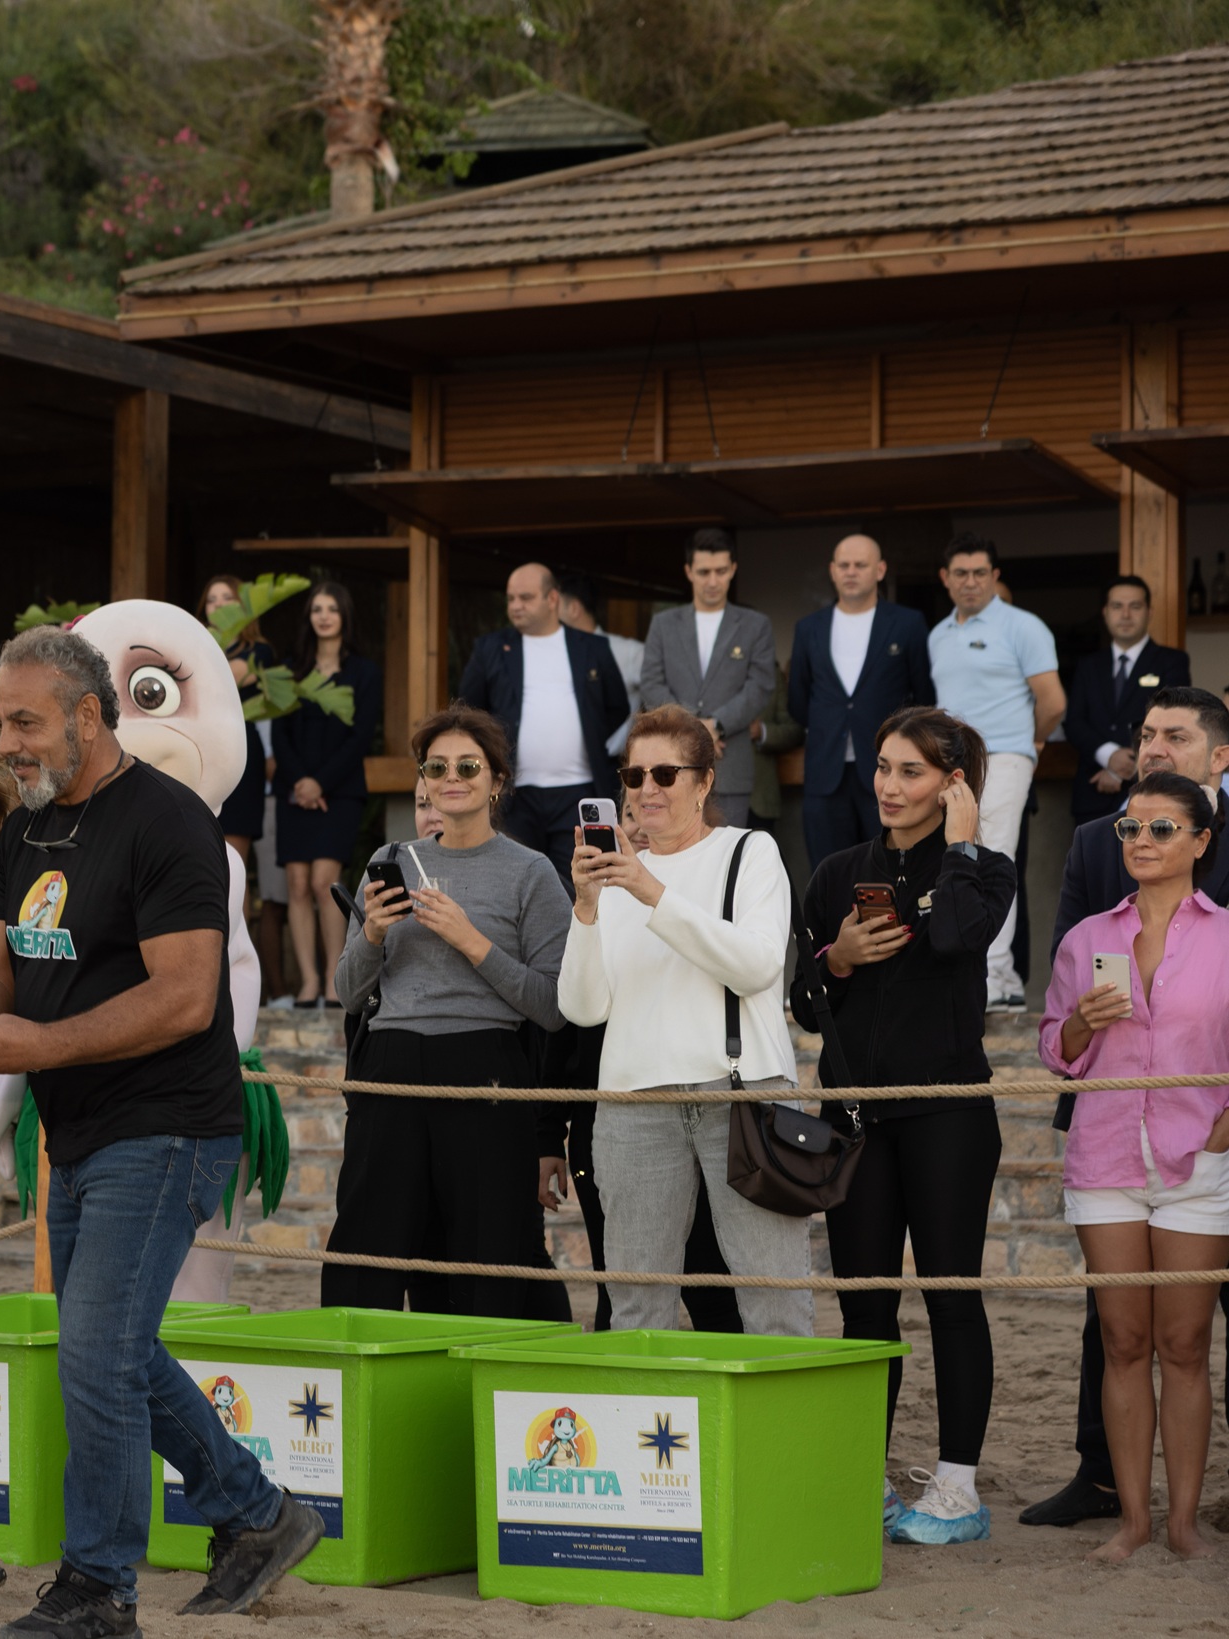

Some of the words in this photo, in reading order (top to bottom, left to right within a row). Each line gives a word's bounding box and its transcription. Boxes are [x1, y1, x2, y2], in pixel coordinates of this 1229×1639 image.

[290, 1455, 334, 1464] INTERNATIONAL
[290, 1465, 308, 1473] HOTELS
[640, 1488, 691, 1498] INTERNATIONAL
[507, 1499, 518, 1507] SEA
[520, 1500, 543, 1508] TURTLE
[545, 1501, 597, 1510] REHABILITATION
[599, 1503, 625, 1512] CENTER
[667, 1501, 692, 1509] RESORTS
